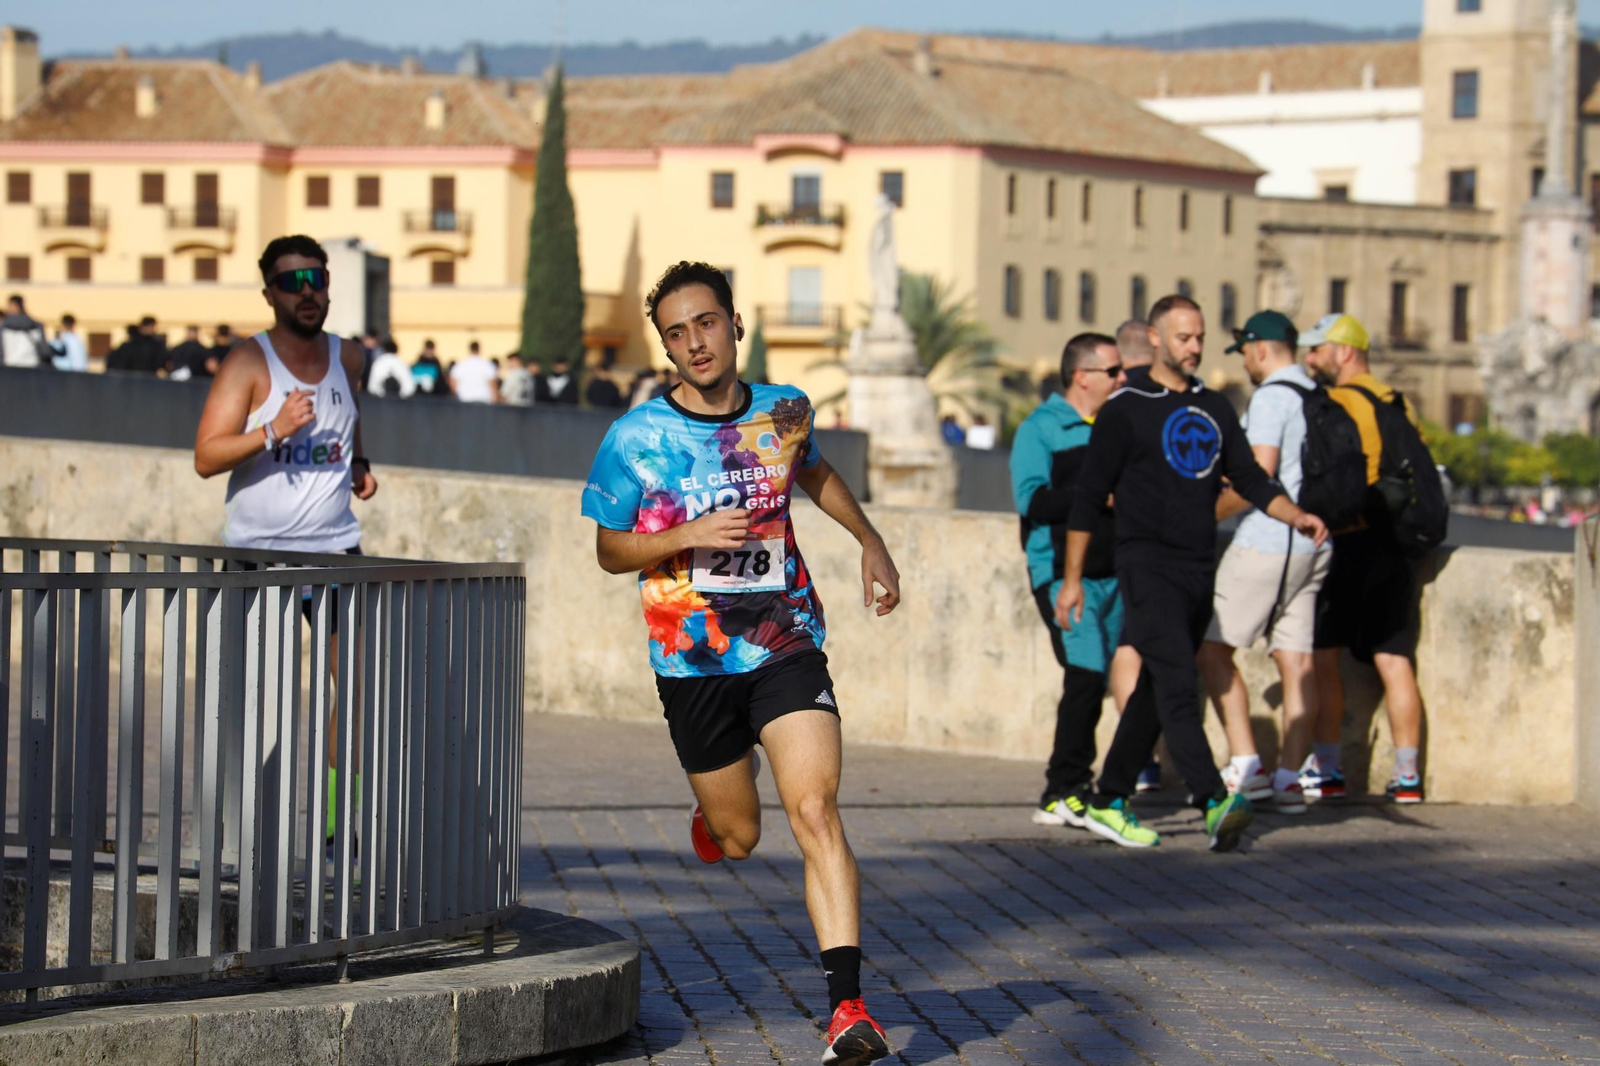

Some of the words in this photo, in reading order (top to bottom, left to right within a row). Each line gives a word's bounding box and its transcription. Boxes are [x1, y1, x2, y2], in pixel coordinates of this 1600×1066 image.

[680, 476, 703, 491] EL
[707, 463, 787, 487] CEREBRO
[745, 482, 771, 497] ES
[684, 488, 741, 522] NO
[745, 494, 786, 510] GRIS
[709, 550, 771, 577] 278
